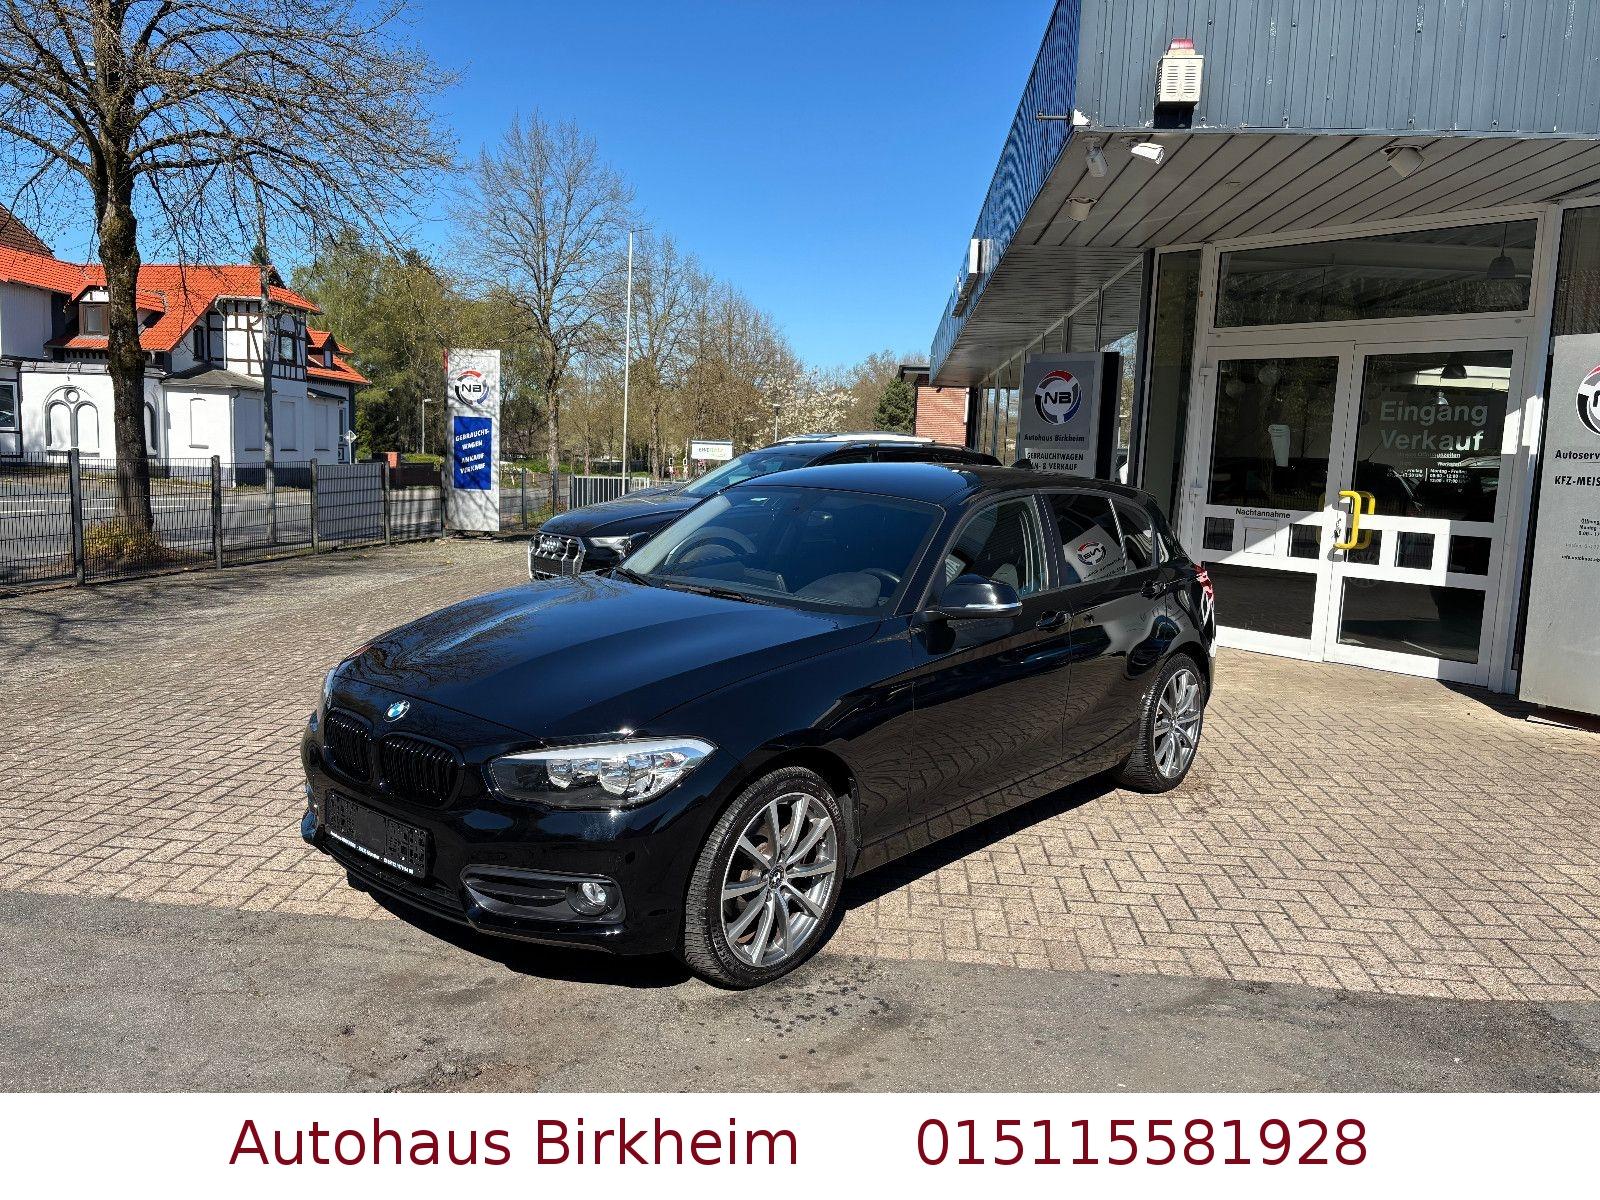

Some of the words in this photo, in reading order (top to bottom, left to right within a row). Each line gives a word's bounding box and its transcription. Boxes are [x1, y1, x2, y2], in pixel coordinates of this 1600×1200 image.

[462, 384, 482, 392] NB
[1044, 391, 1072, 404] NB
[1380, 401, 1488, 427] Eingang
[1024, 433, 1053, 442] Autohaus
[1054, 433, 1085, 442] Birkheim
[1380, 429, 1485, 451] Verkauf
[462, 440, 483, 450] WAGEN
[461, 453, 485, 463] ANKAUF
[1027, 452, 1084, 461] GEBRAUCHTWAGEN
[1049, 462, 1078, 471] VERKAUF
[1235, 507, 1291, 519] Nachtannahme
